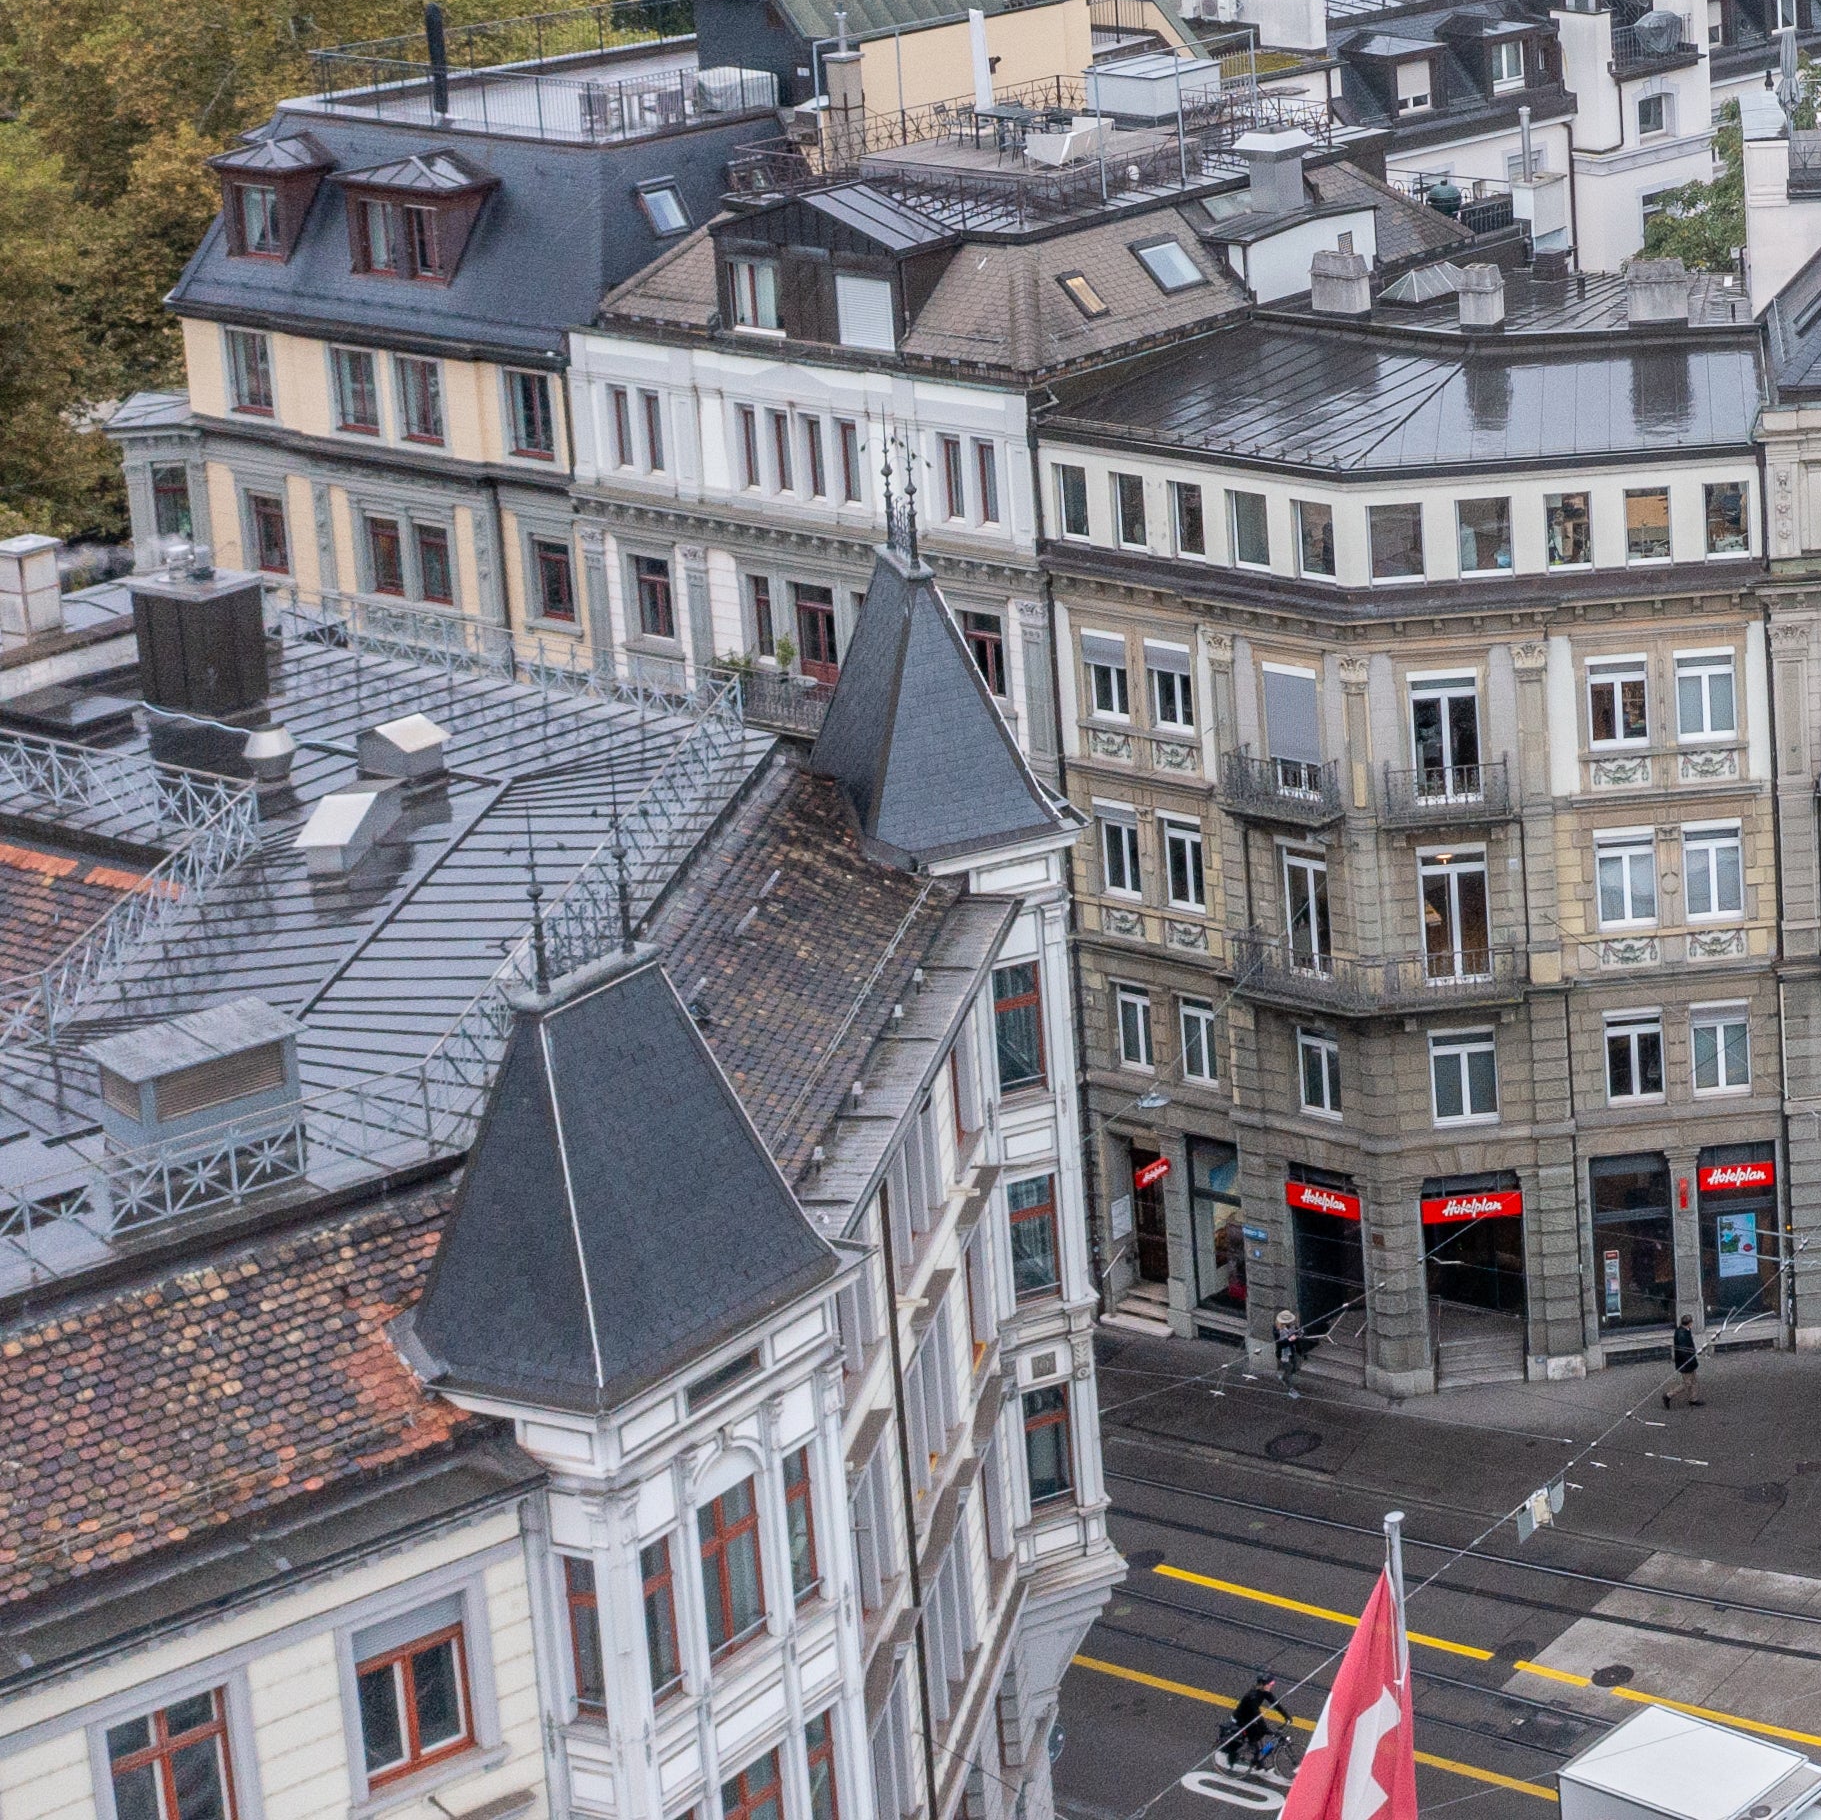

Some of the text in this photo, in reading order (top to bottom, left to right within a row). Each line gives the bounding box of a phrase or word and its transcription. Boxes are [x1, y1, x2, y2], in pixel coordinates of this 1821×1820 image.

[1707, 1166, 1767, 1186] Hotelplan
[1300, 1188, 1347, 1213] Hotelplan
[1442, 1197, 1503, 1219] Hotelplan
